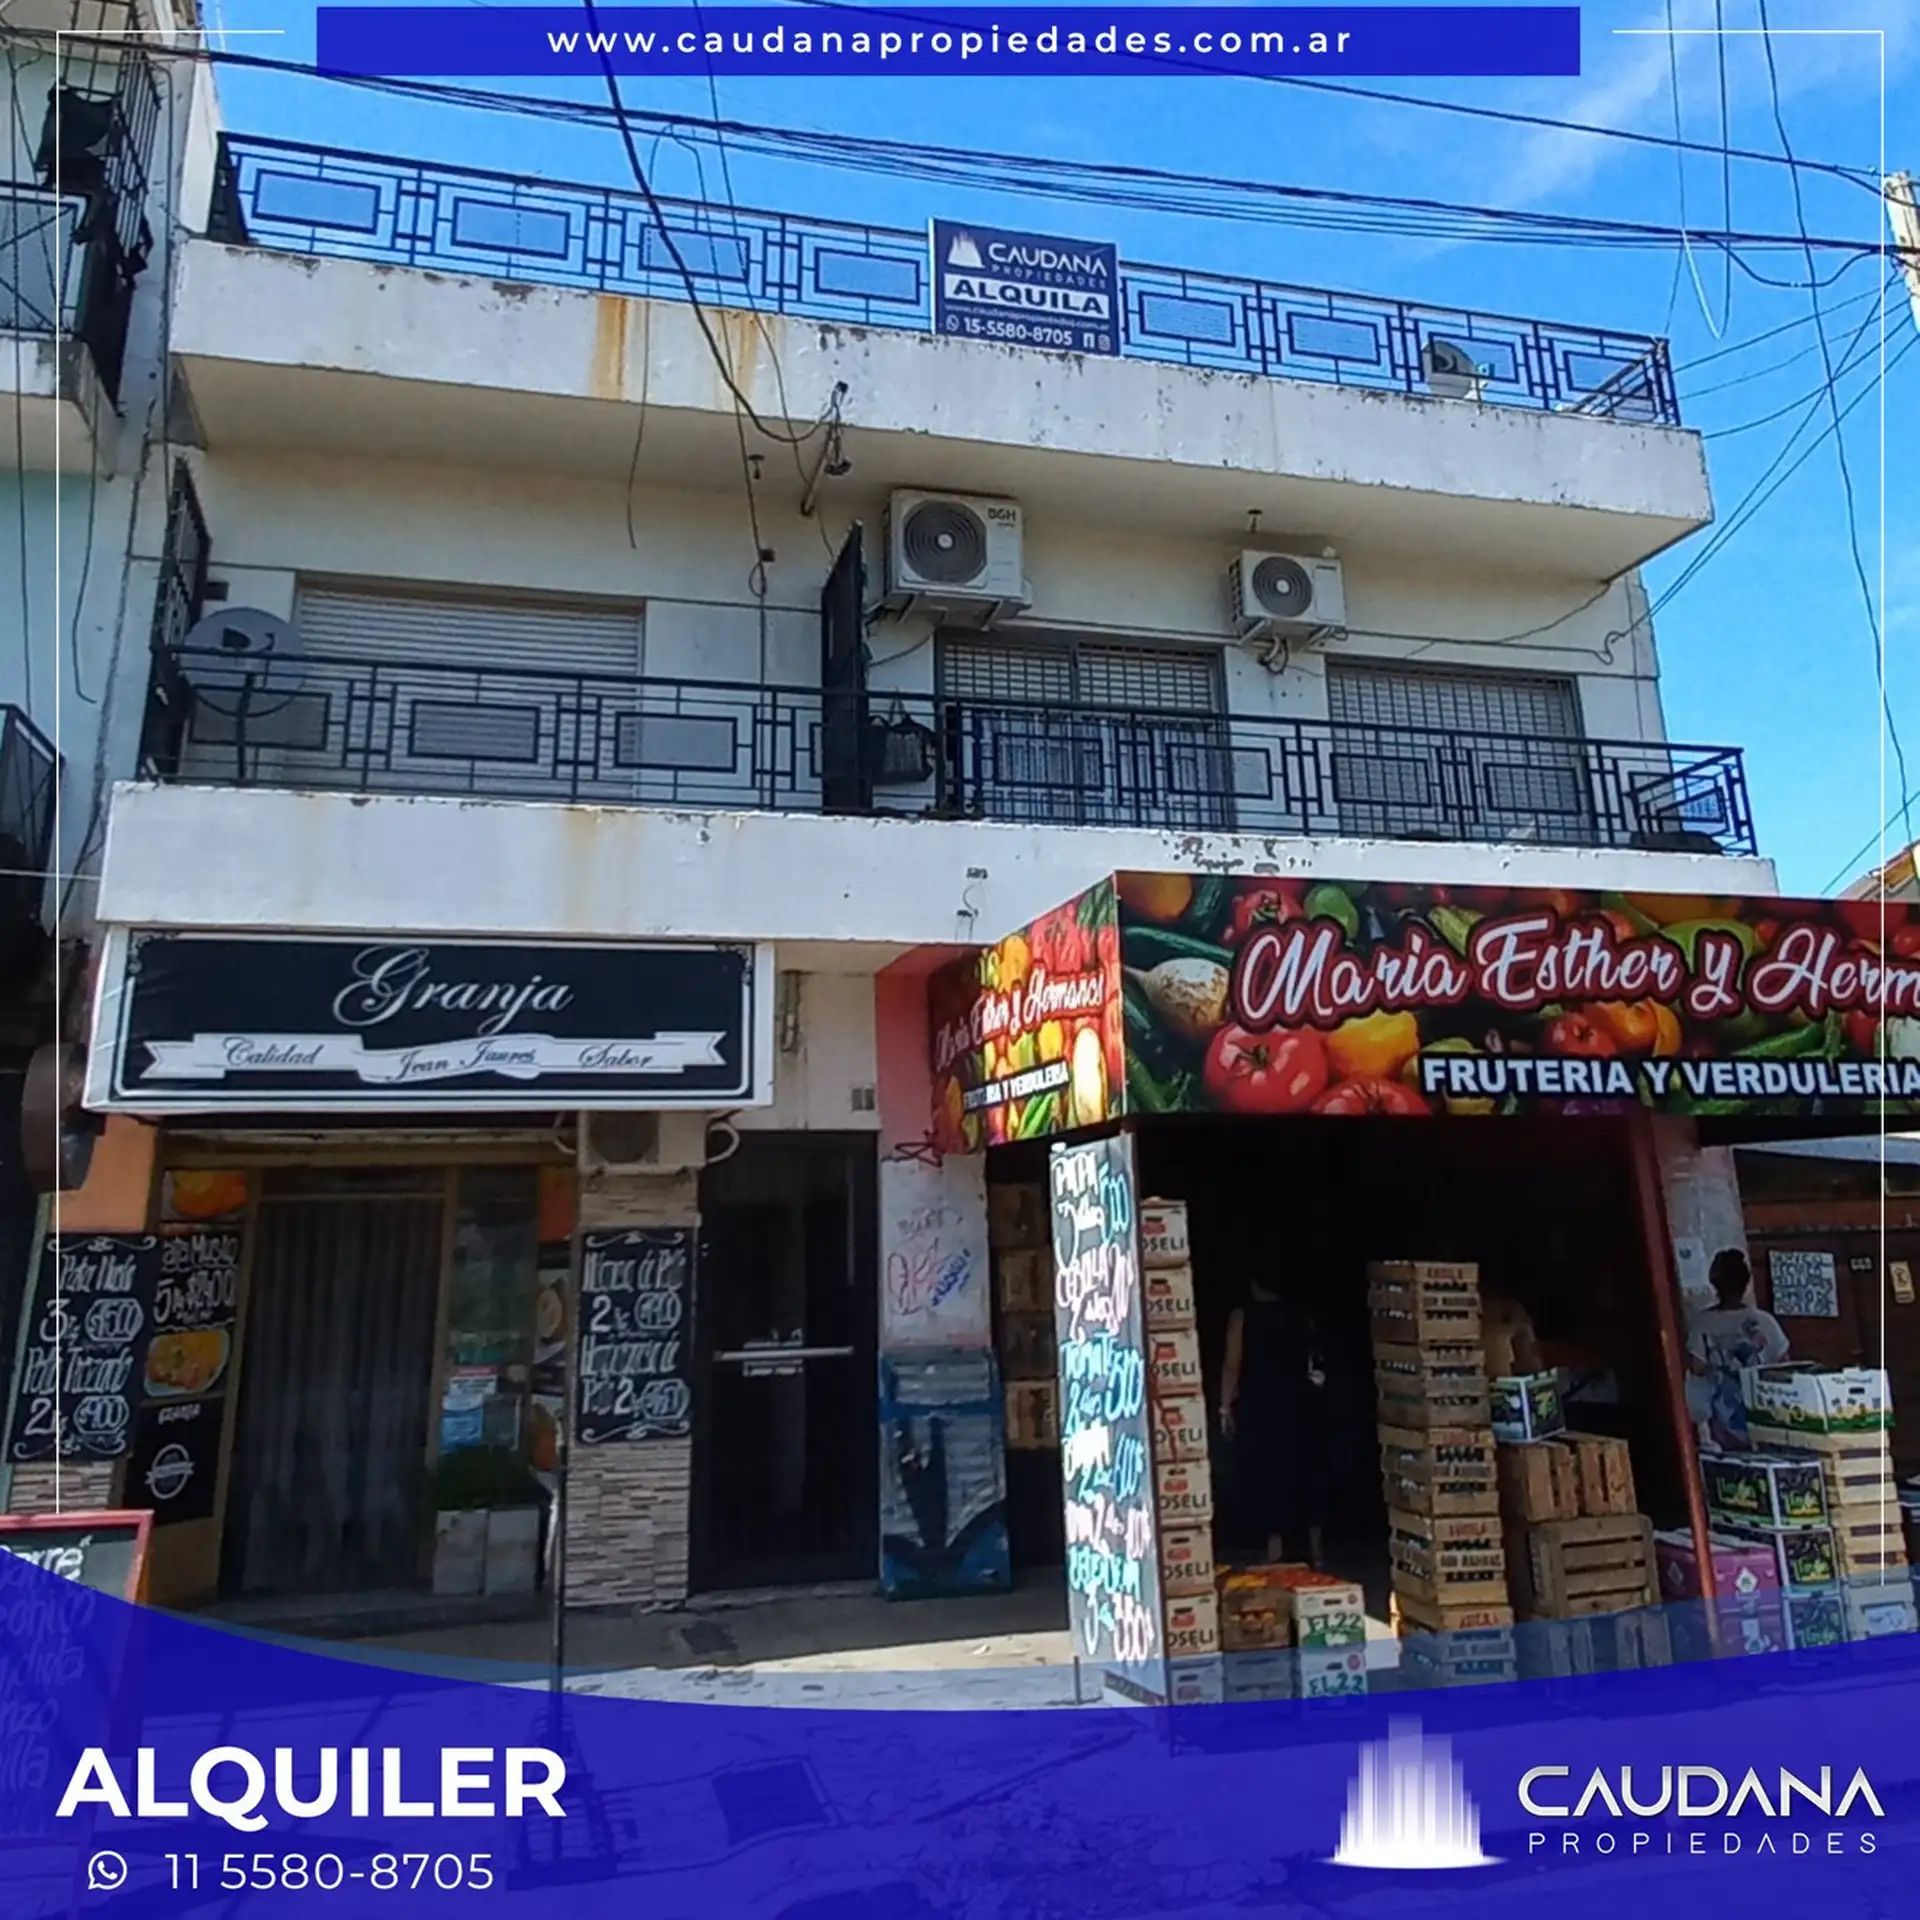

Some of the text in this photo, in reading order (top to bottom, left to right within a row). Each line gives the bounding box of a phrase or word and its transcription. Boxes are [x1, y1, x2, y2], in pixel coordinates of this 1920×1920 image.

[988, 242, 1108, 277] CAUDANA
[992, 264, 1107, 290] PROPIEDADES
[952, 279, 1104, 315] ALQUILA
[963, 316, 1073, 346] 15-5580-8705
[987, 506, 1017, 522] BGH
[1245, 925, 1465, 1020] Maria
[1478, 917, 1678, 1002] Esther
[1692, 940, 1730, 1022] y
[333, 944, 575, 1036] Granja
[222, 1035, 325, 1067] Calidad
[386, 1048, 449, 1082] Jean
[577, 1043, 655, 1069] Sabor
[1425, 1057, 1920, 1097] FRUTERIA Y VERDULERIA
